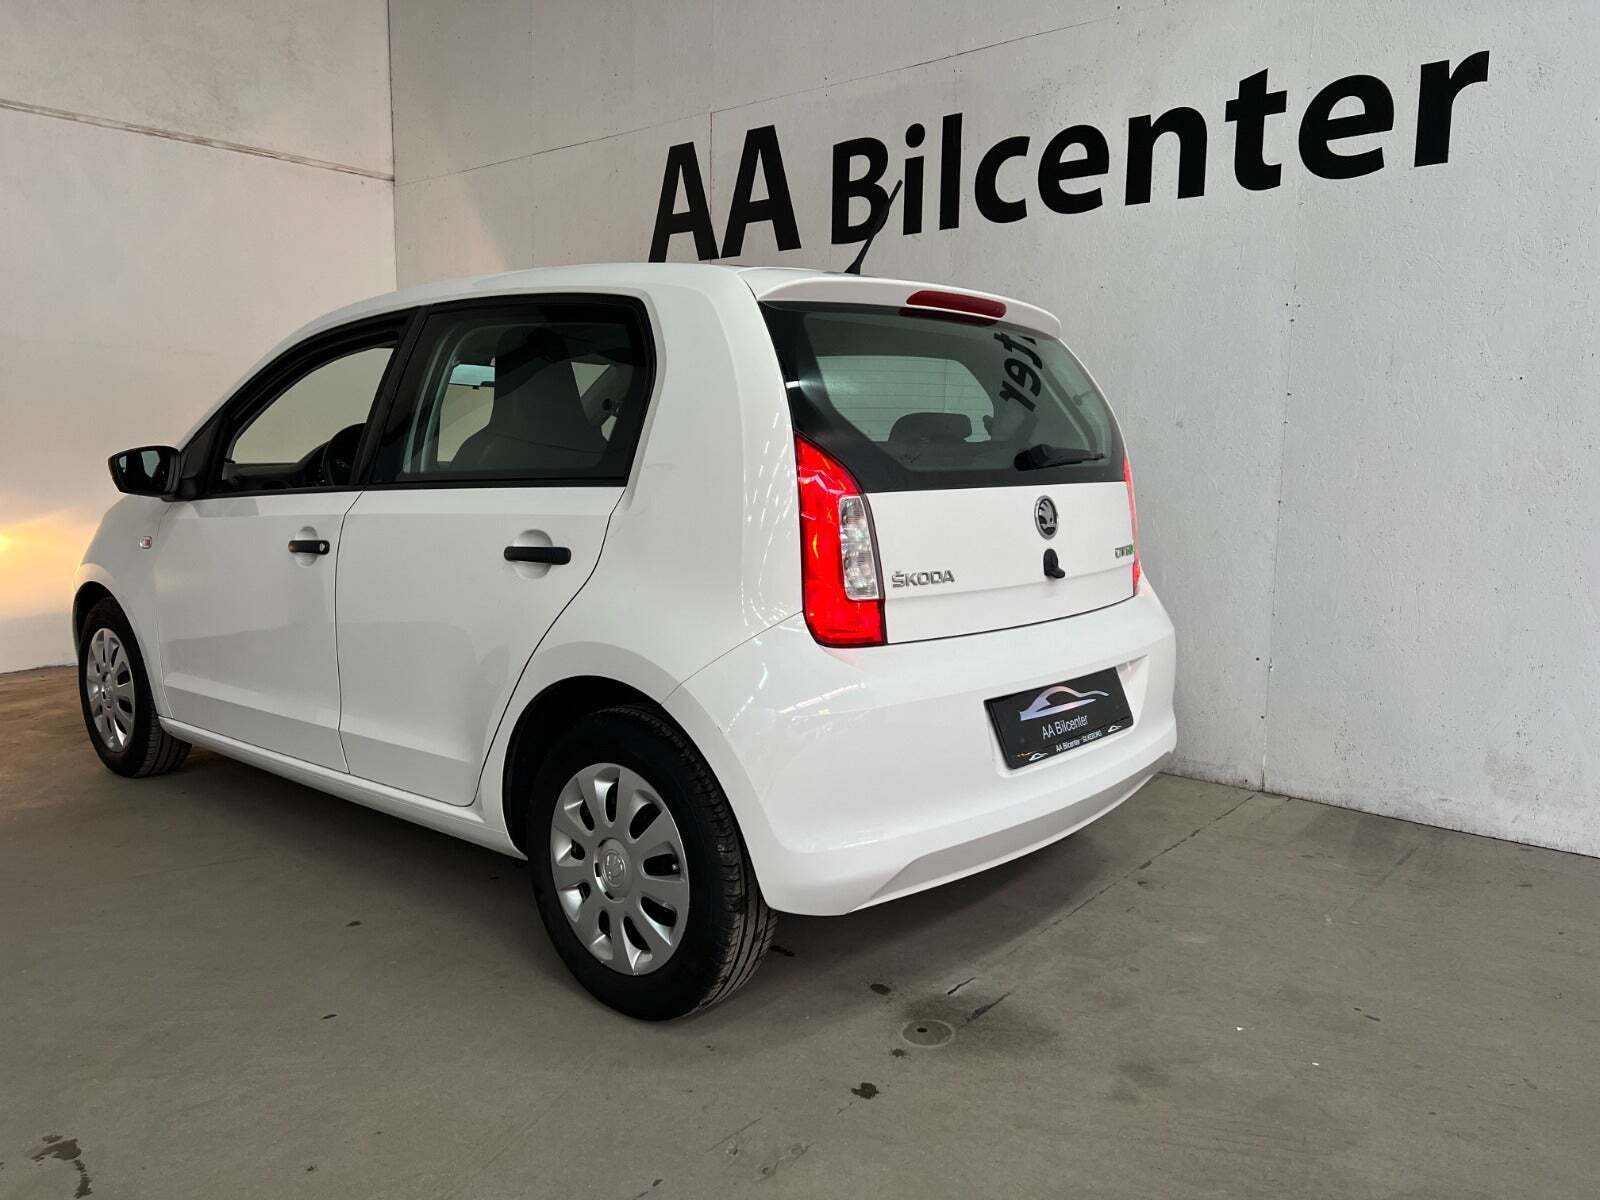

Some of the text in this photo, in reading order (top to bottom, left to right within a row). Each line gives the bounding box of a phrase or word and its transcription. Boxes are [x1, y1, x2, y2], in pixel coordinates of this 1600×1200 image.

[649, 51, 1490, 263] AA Bilcenter
[891, 570, 956, 588] ŠKODA
[1042, 715, 1088, 740] AA Bilcenter
